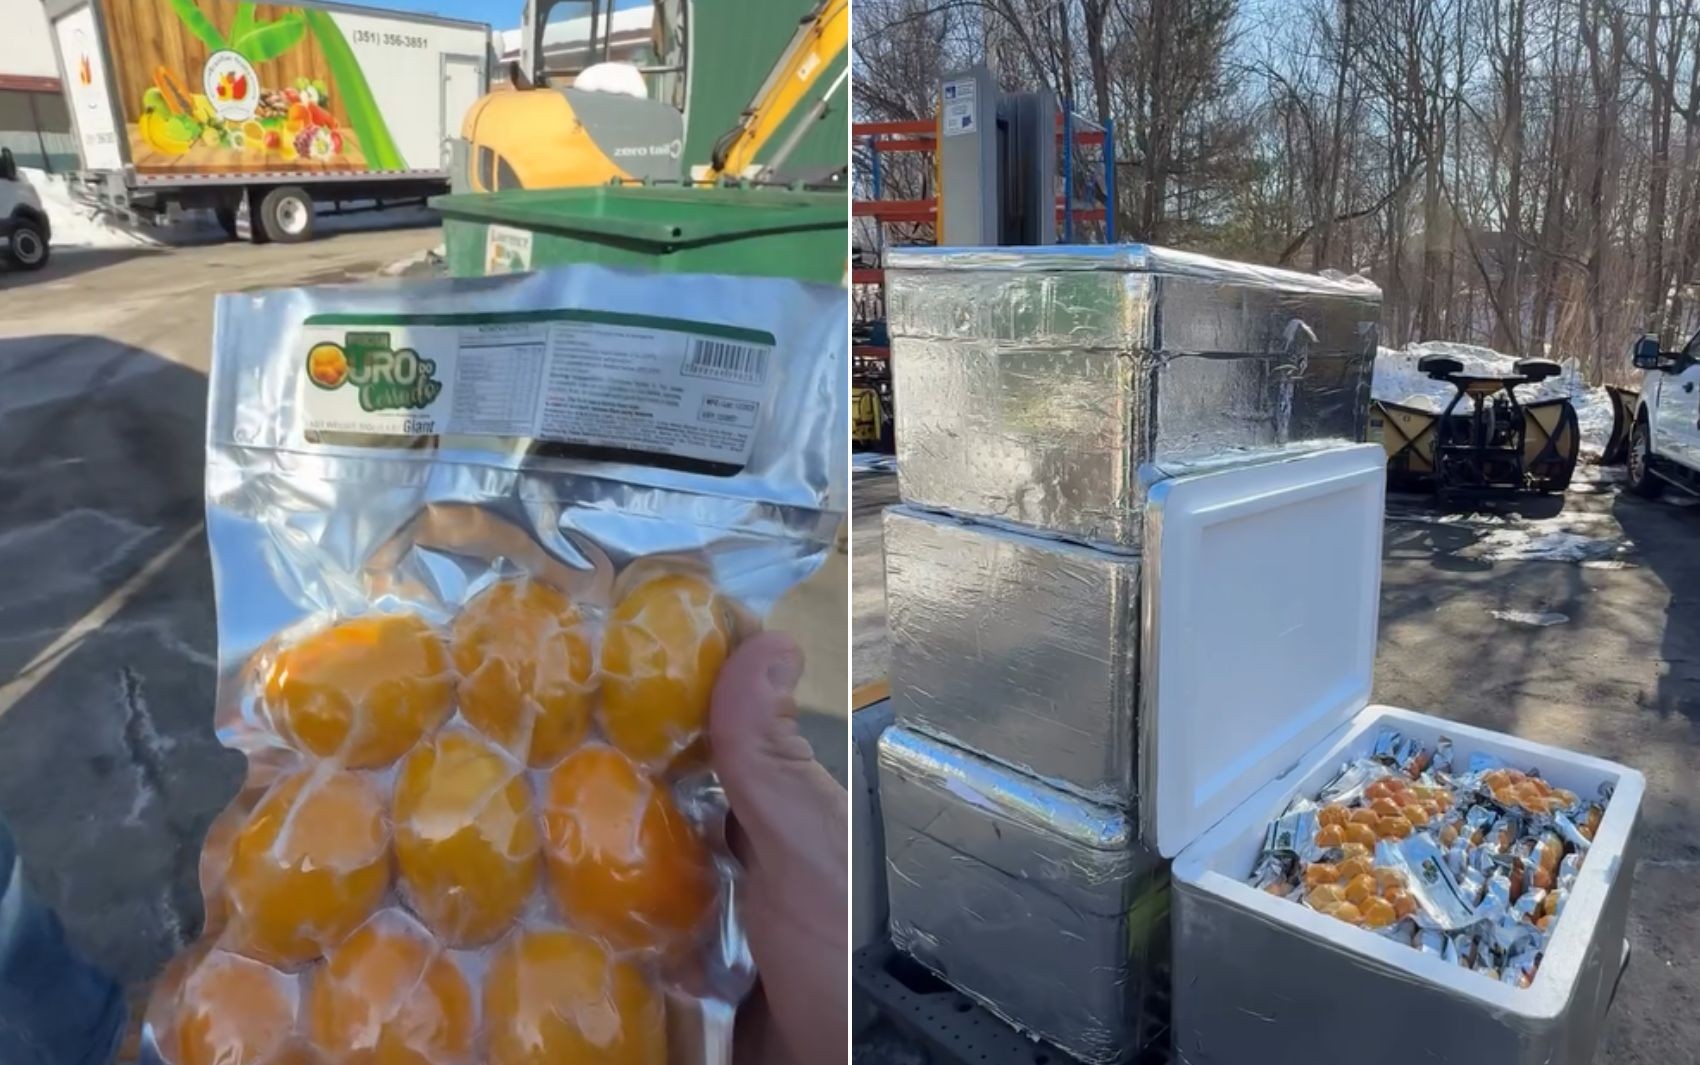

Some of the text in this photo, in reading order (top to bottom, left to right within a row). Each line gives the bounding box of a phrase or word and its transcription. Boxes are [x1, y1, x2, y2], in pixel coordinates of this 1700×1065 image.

[353, 30, 428, 48] (351) 356-3851
[614, 143, 670, 157] zero tail
[403, 417, 435, 433] Giant
